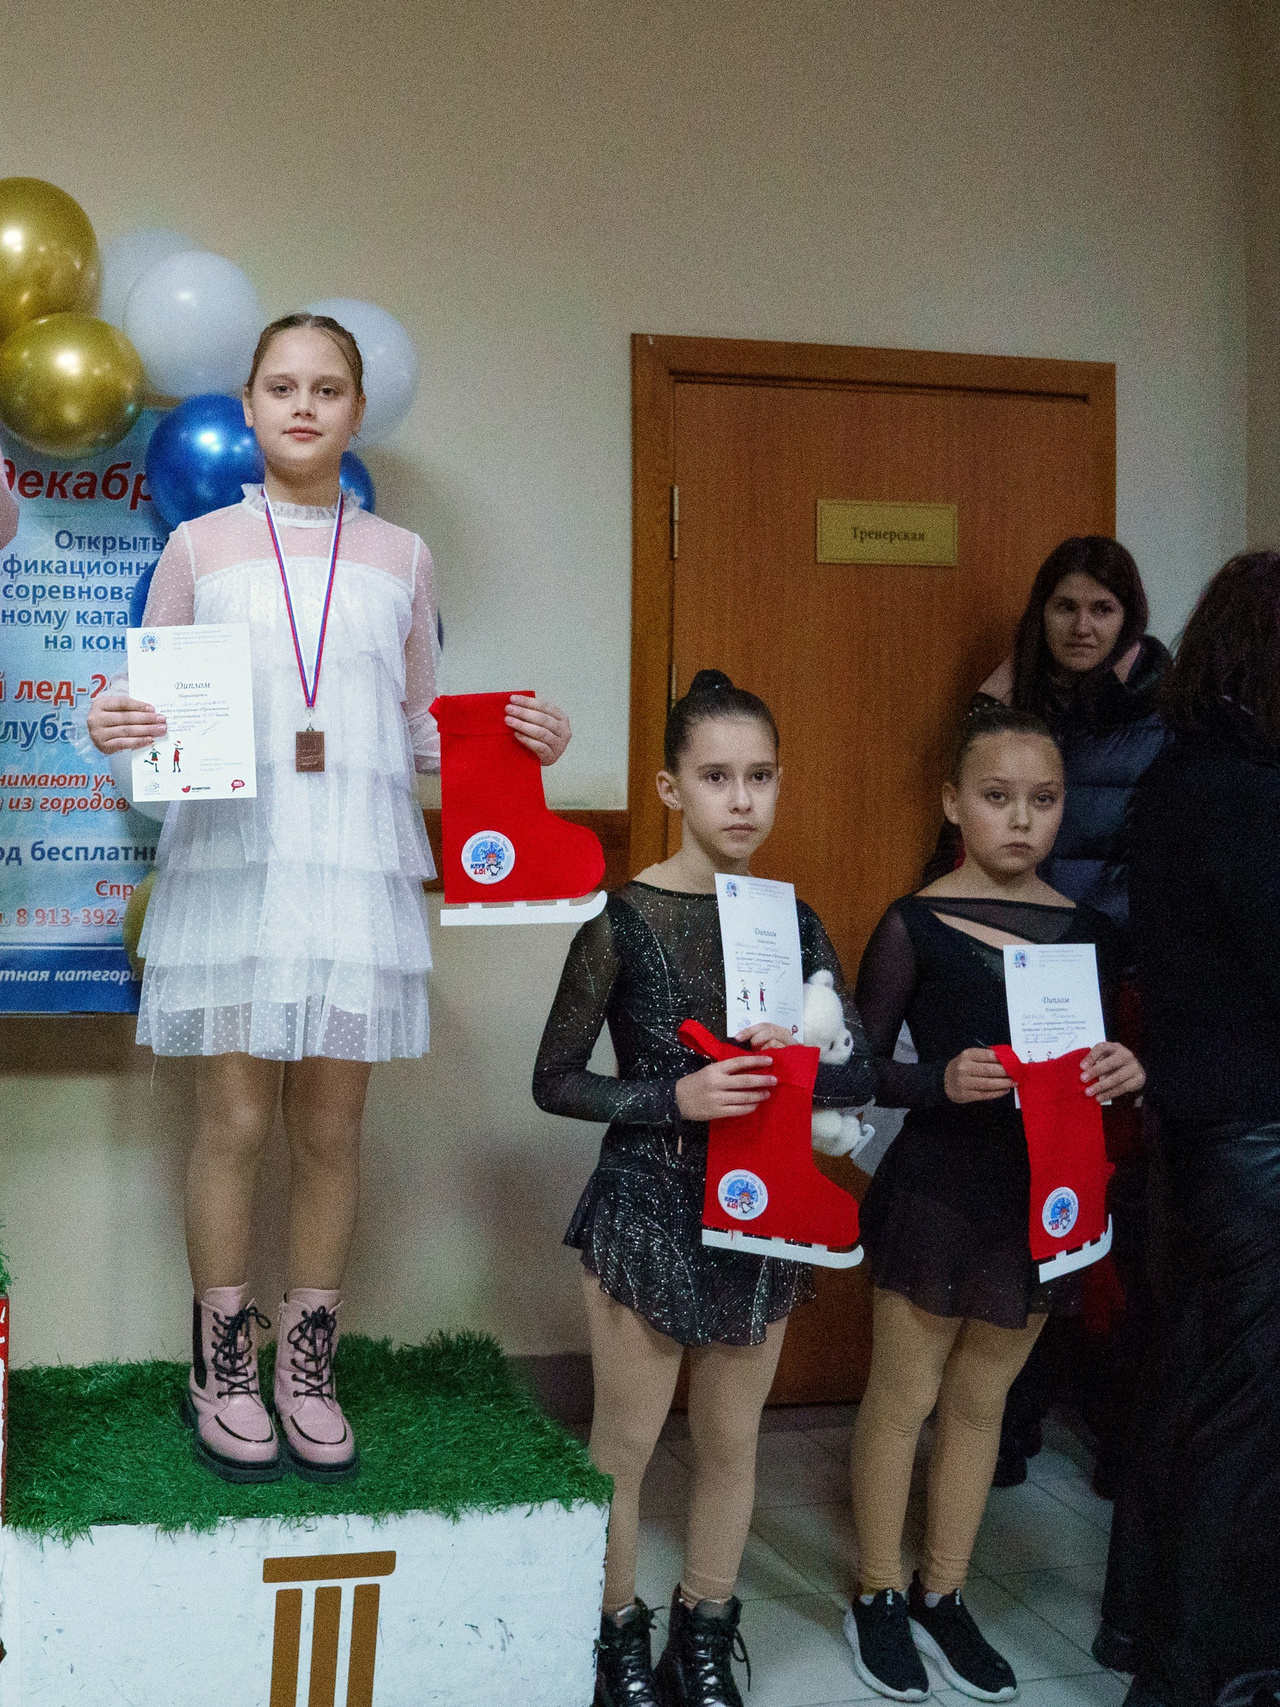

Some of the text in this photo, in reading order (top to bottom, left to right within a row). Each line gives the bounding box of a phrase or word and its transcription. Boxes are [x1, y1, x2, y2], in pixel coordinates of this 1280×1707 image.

[851, 526, 926, 545] Тренерская
[76, 609, 128, 626] ката
[44, 634, 126, 650] на кон
[14, 673, 111, 707] лед-2
[174, 681, 211, 690] Диплом
[8, 795, 34, 811] из
[95, 880, 136, 900] Спр
[16, 908, 28, 925] 8
[34, 908, 125, 926] 913-392-
